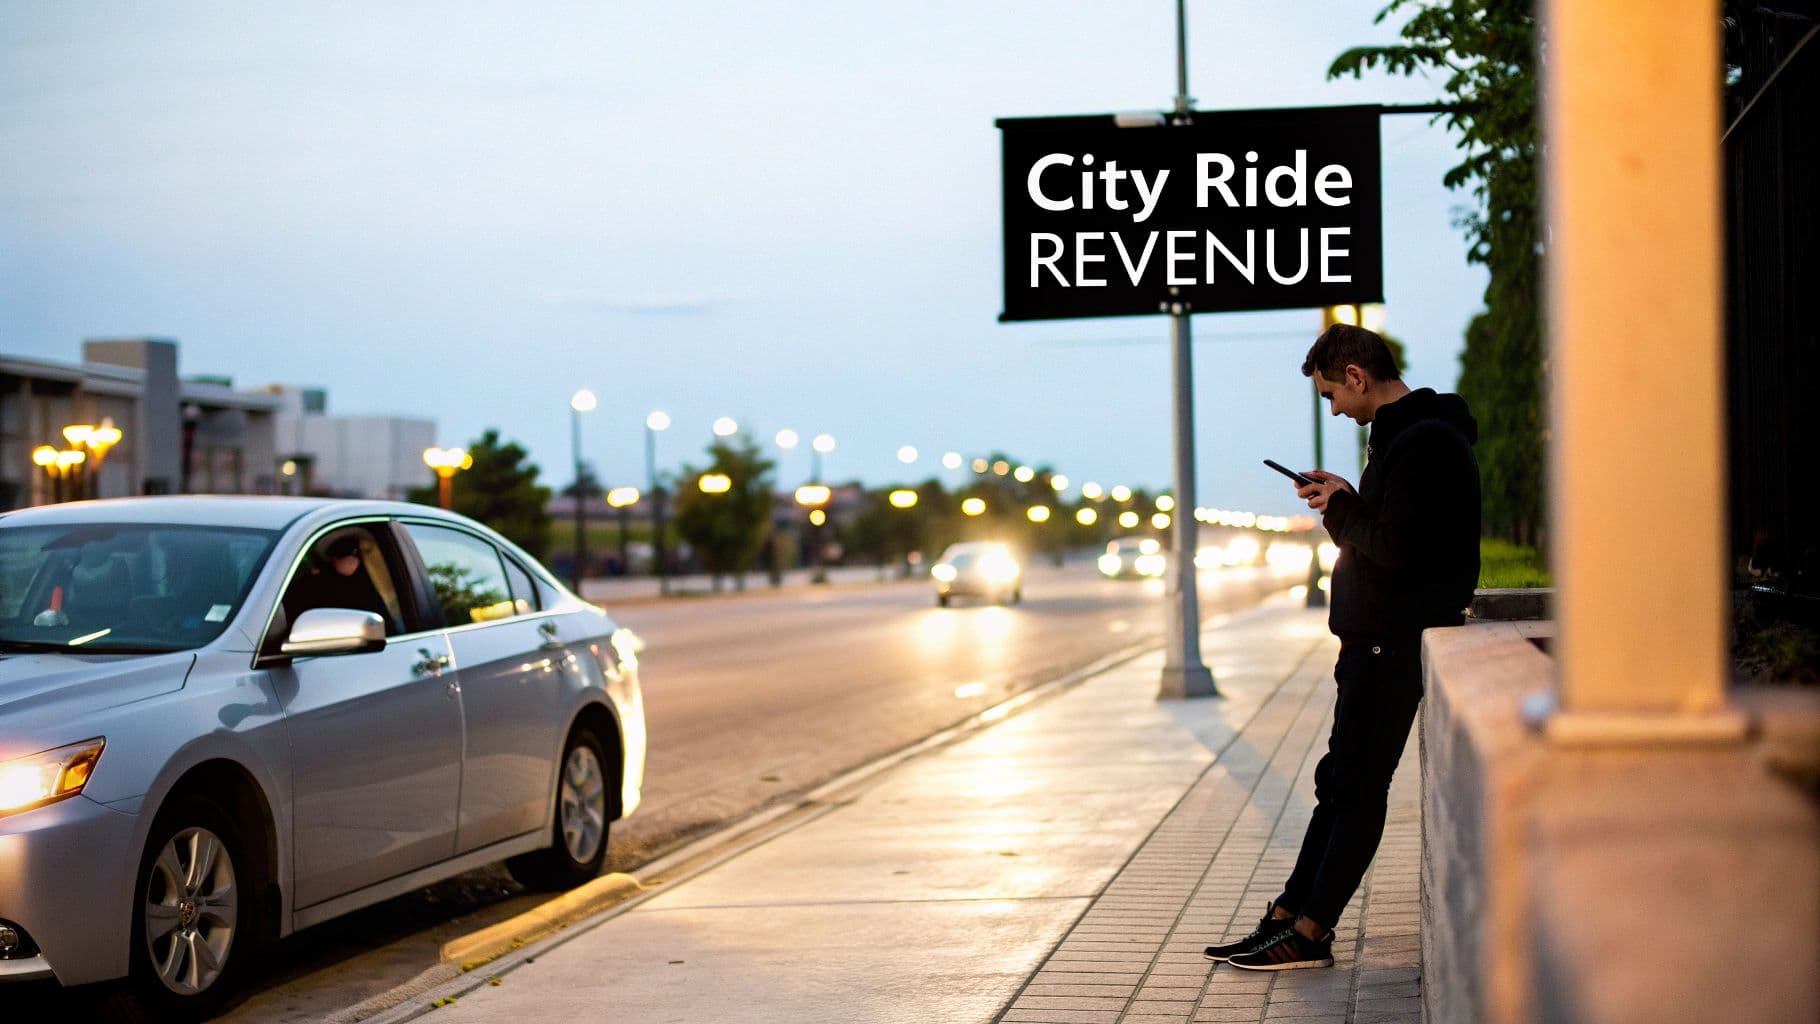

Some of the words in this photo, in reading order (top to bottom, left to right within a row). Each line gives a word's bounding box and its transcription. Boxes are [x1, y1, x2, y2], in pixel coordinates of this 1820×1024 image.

[1027, 152, 1171, 223] City
[1196, 149, 1353, 208] Ride
[1030, 226, 1352, 288] REVENUE
